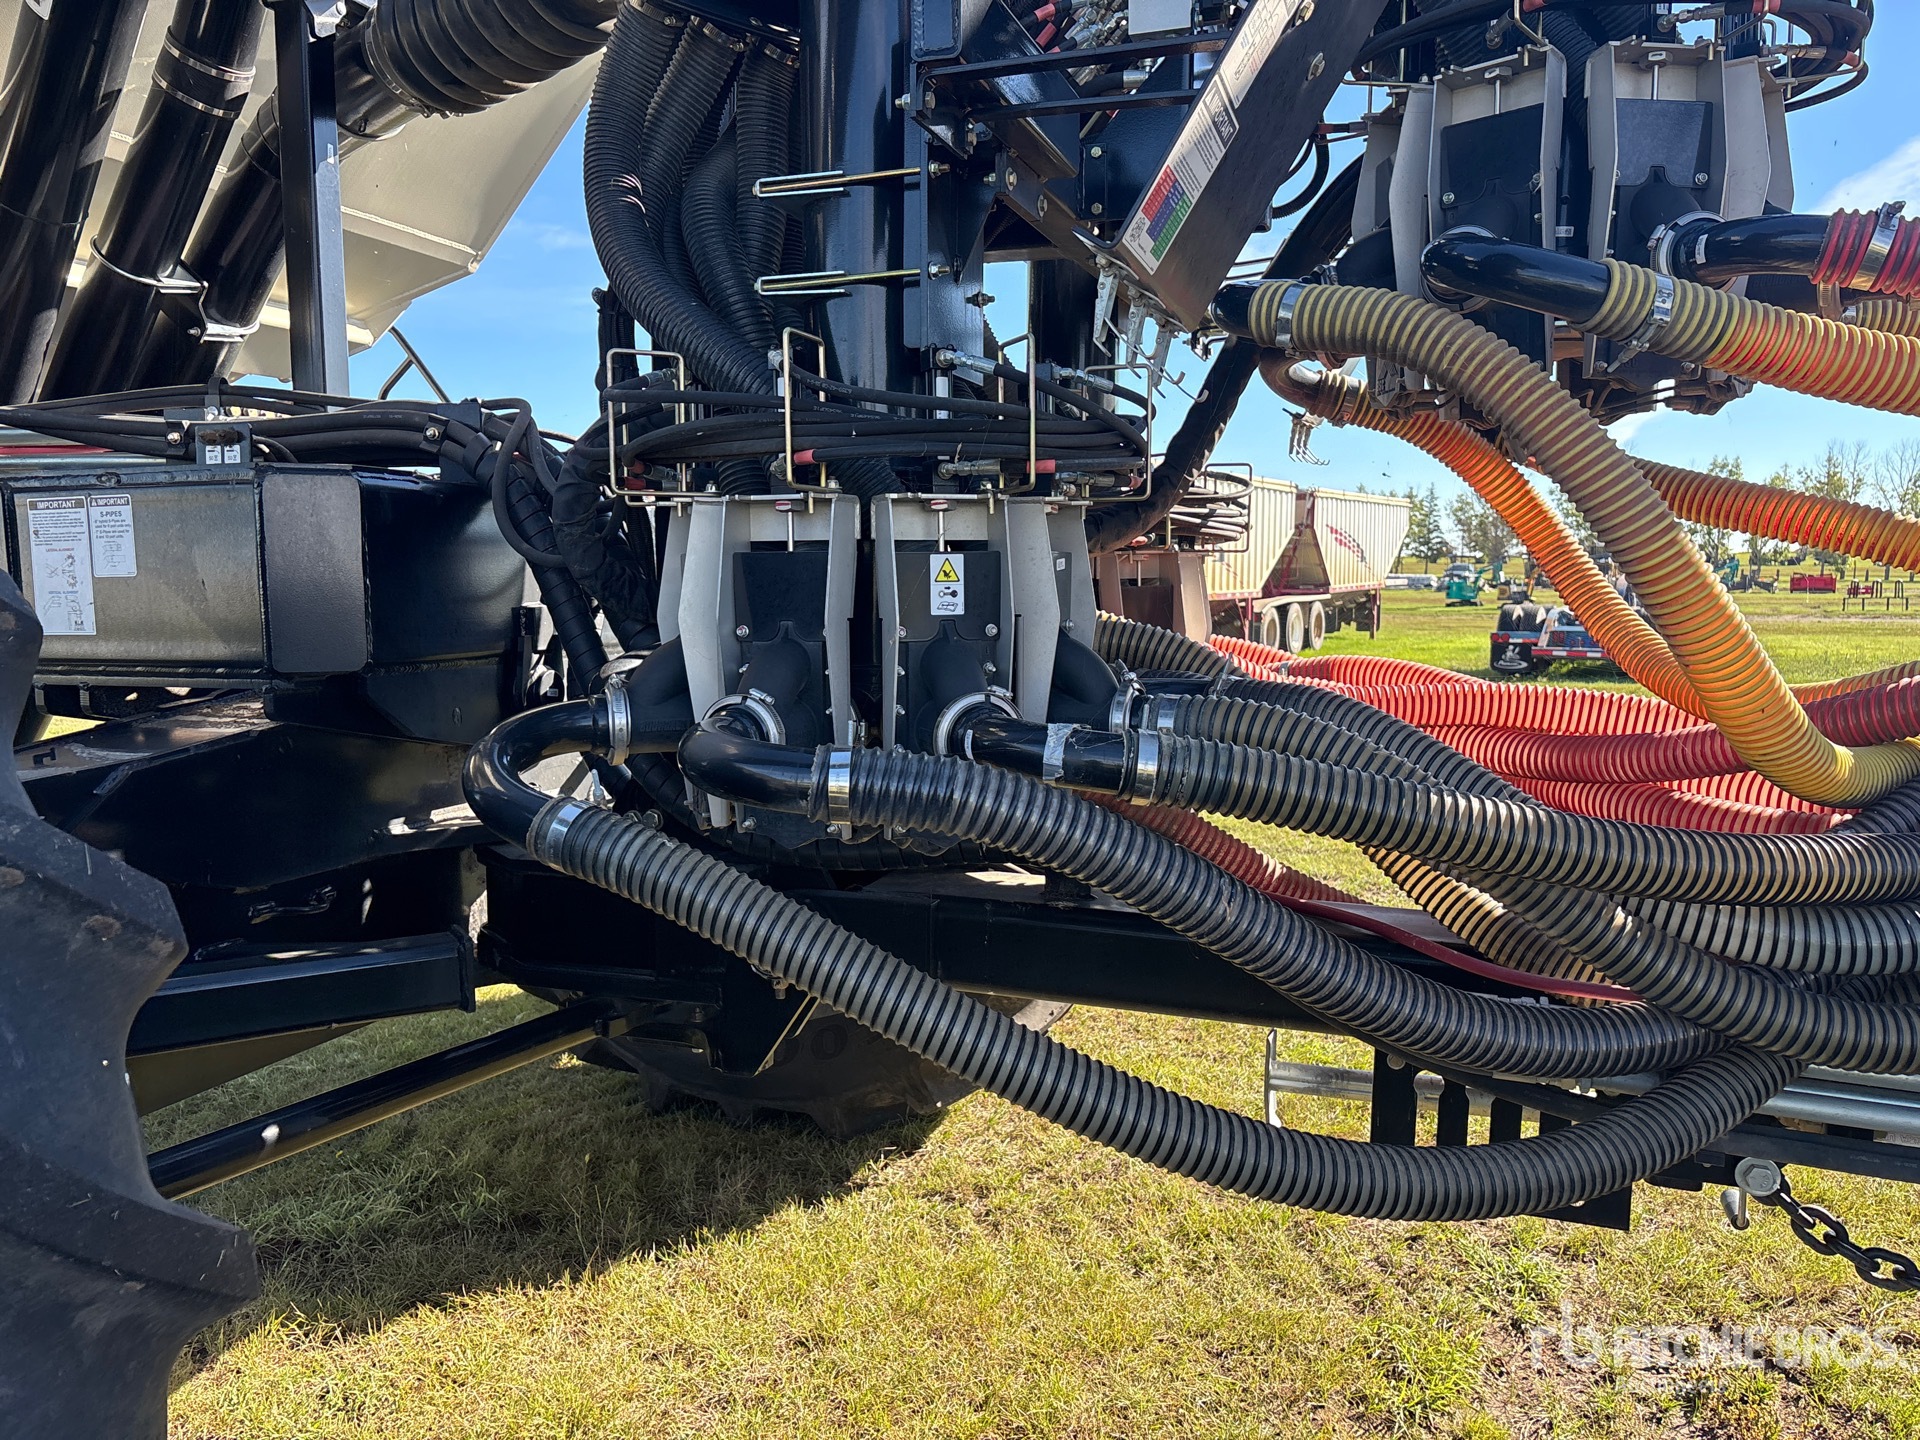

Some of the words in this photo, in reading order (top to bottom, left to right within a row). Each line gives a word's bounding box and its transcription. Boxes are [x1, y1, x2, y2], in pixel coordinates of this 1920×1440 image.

[1208, 93, 1234, 142] IMPORTANT
[37, 500, 76, 509] IMPORTANT
[100, 510, 122, 518] S-PIPES
